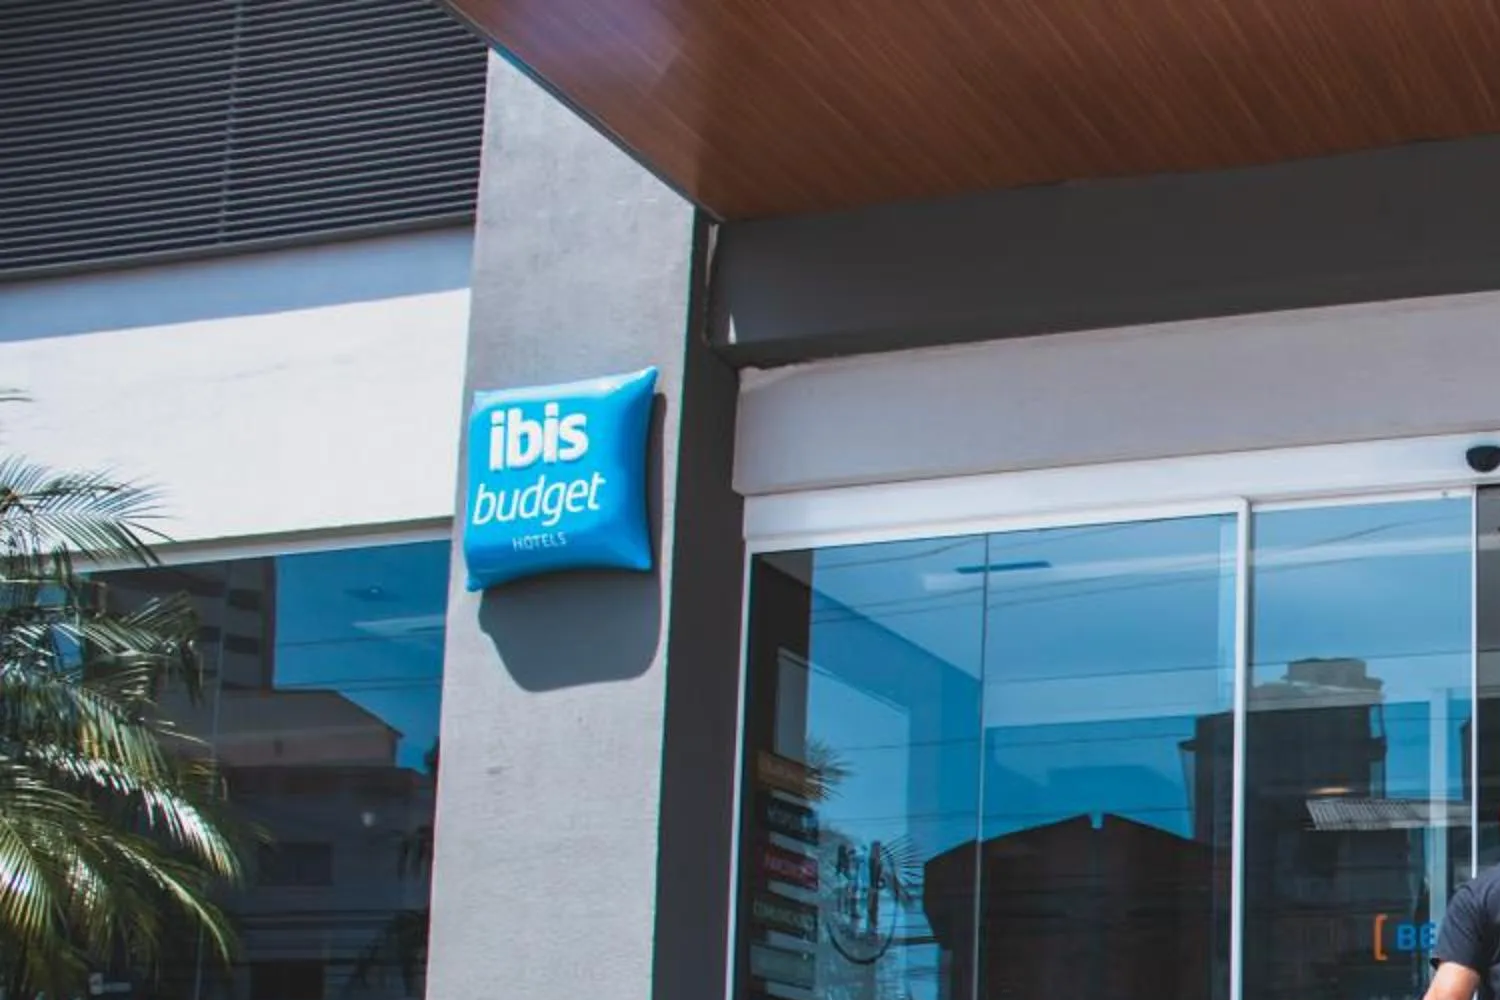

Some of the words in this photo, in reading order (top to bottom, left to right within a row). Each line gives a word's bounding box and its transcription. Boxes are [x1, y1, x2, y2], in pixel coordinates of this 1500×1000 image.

[489, 402, 589, 472] ibis
[471, 471, 606, 527] budget
[511, 530, 567, 552] HOTELS
